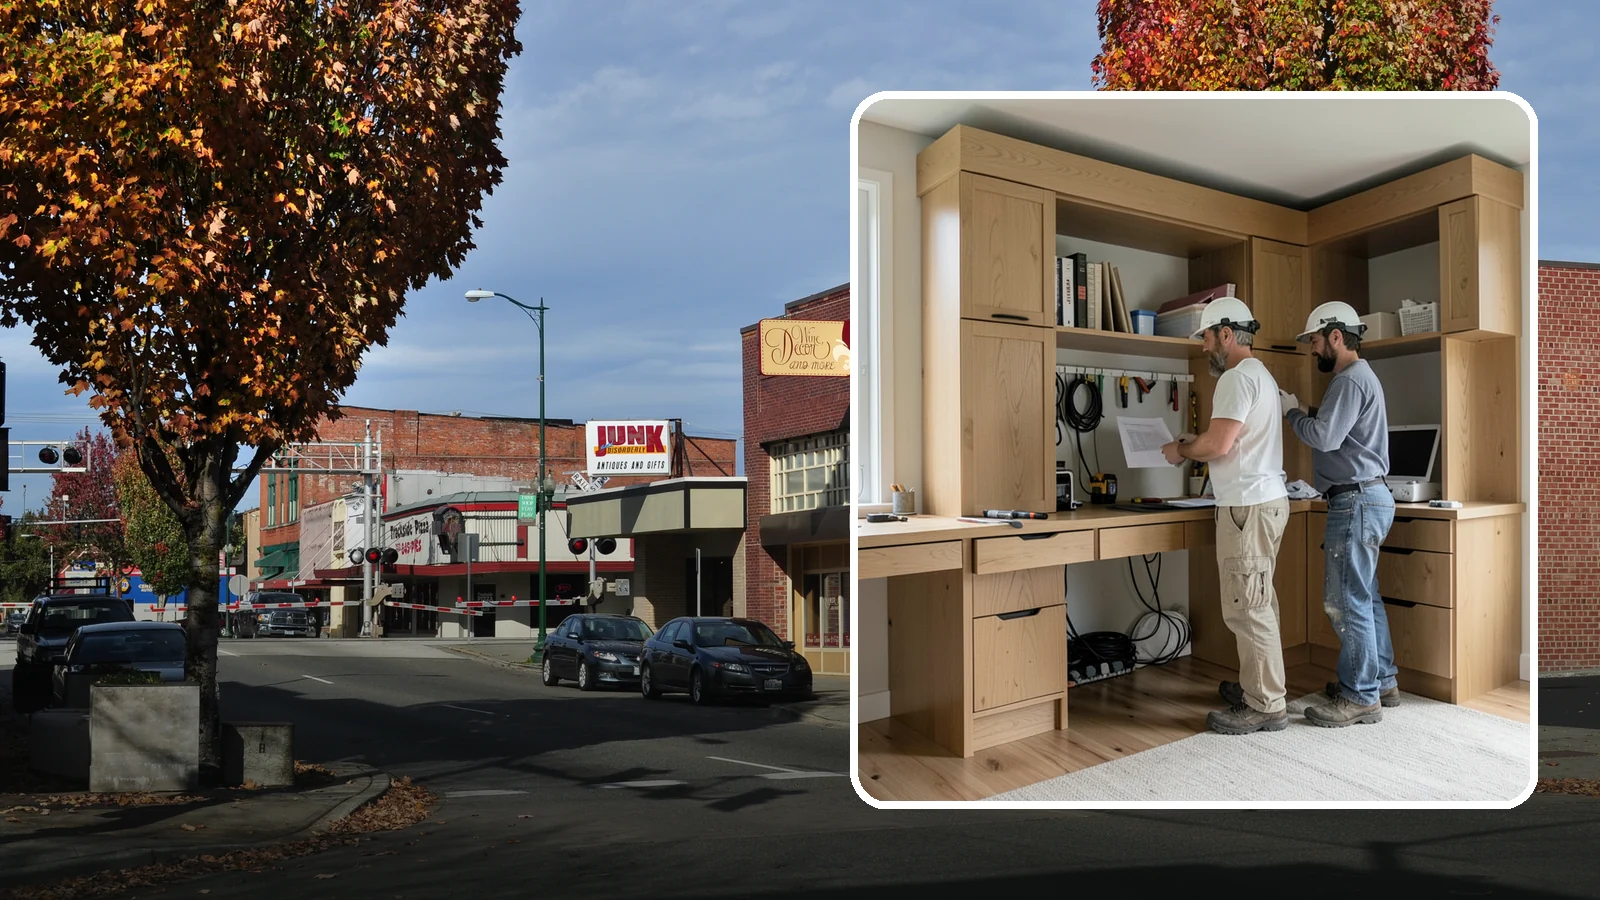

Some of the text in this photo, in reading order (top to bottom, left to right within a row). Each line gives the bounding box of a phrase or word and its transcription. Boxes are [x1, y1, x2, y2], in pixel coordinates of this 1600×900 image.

[595, 425, 666, 457] JUNK
[607, 445, 646, 454] DISORDERLY
[597, 460, 666, 470] ANTIQUES AND GIFTS
[390, 519, 429, 540] Trackside Pizza
